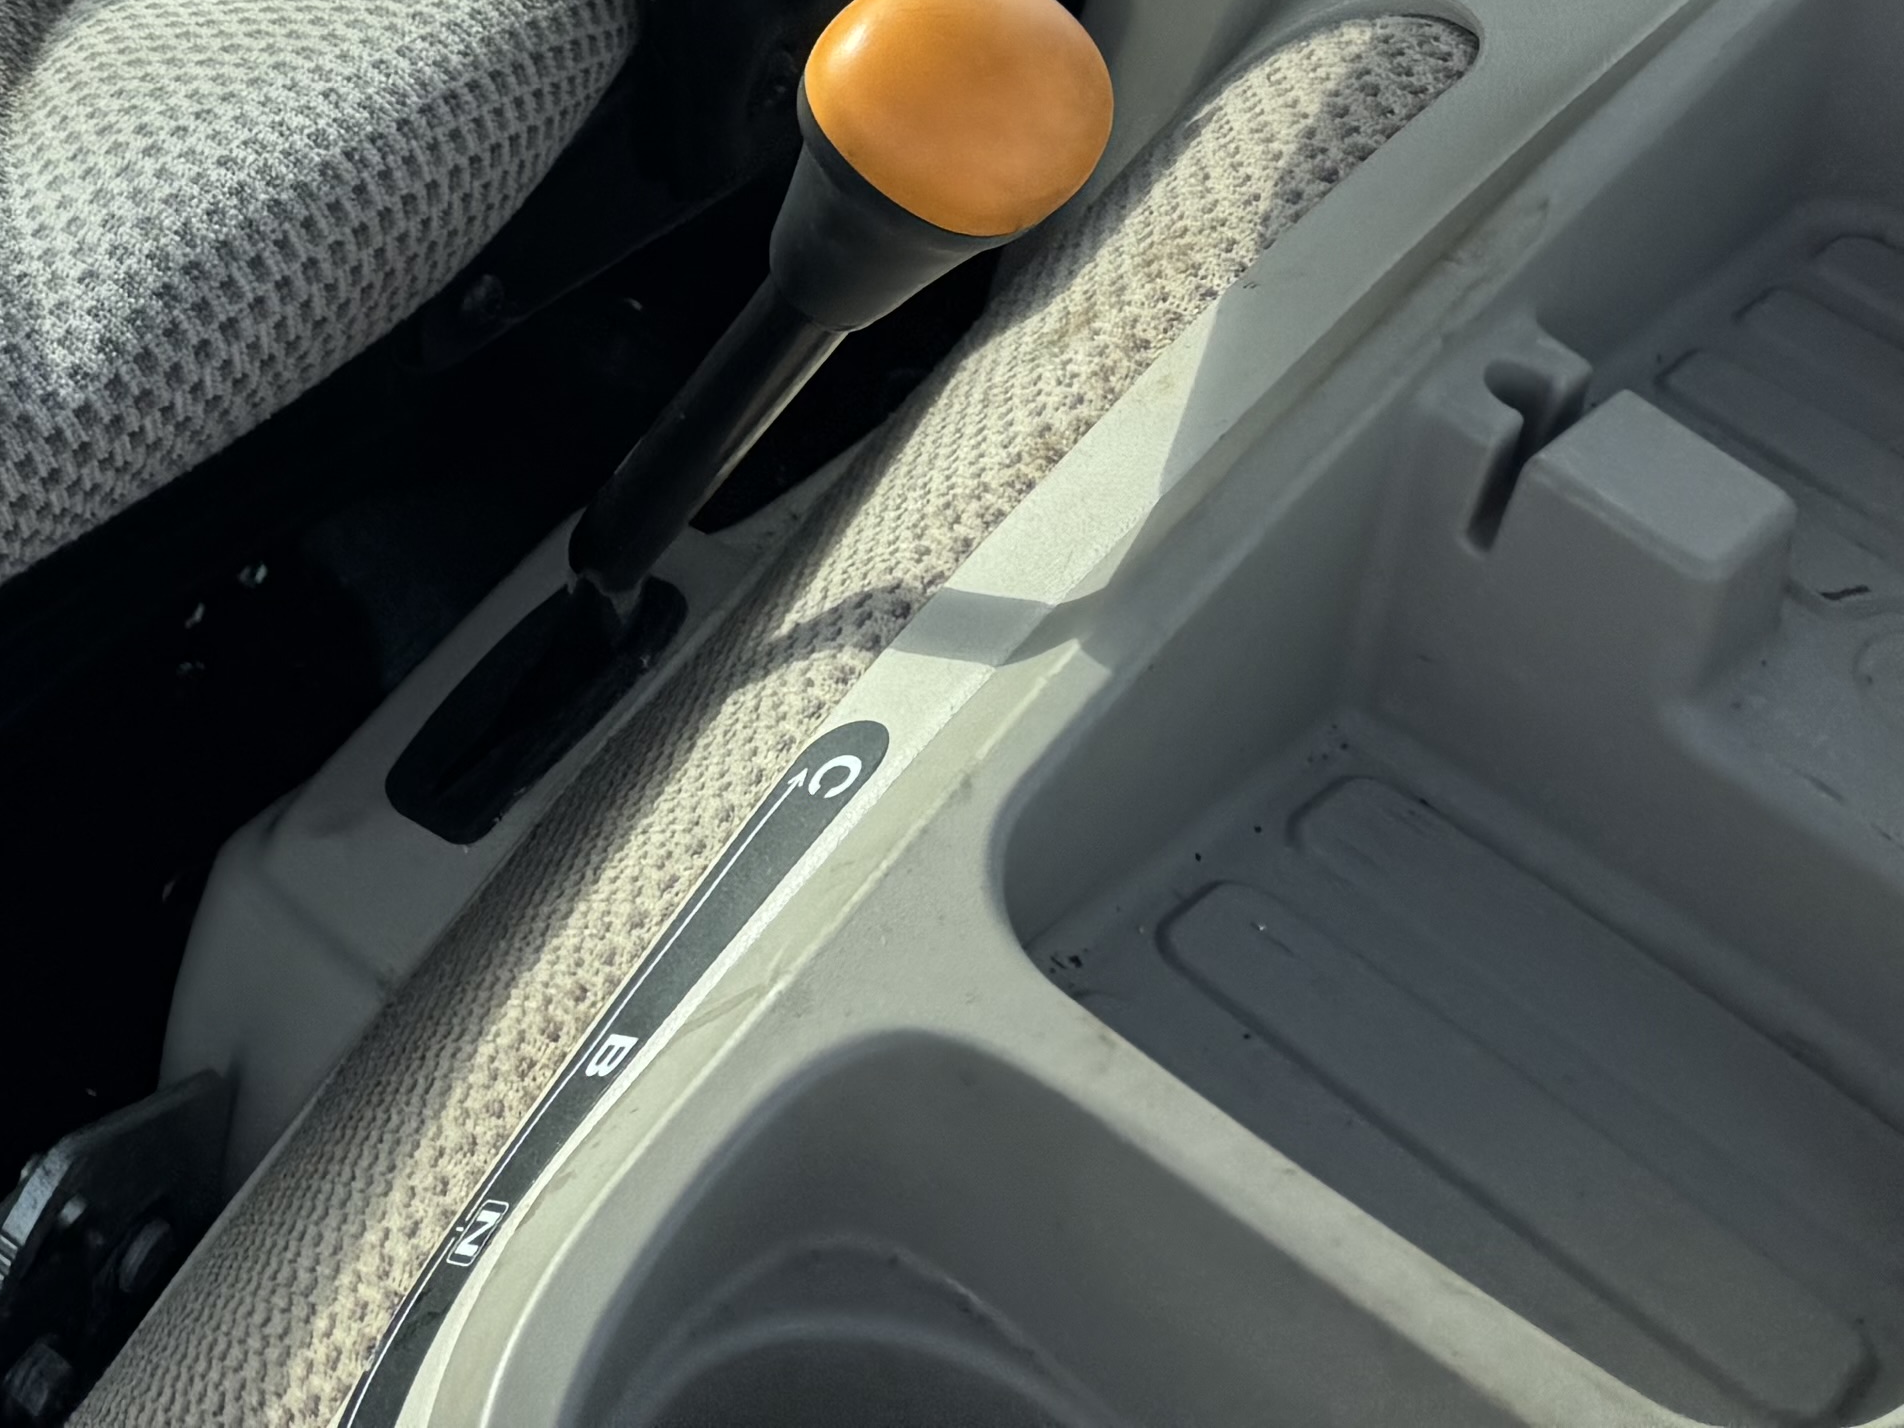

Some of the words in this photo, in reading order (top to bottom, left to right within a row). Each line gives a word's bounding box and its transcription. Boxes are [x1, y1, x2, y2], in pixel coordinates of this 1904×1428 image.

[808, 754, 862, 799] C
[585, 1033, 639, 1077] B
[454, 1210, 501, 1257] N
